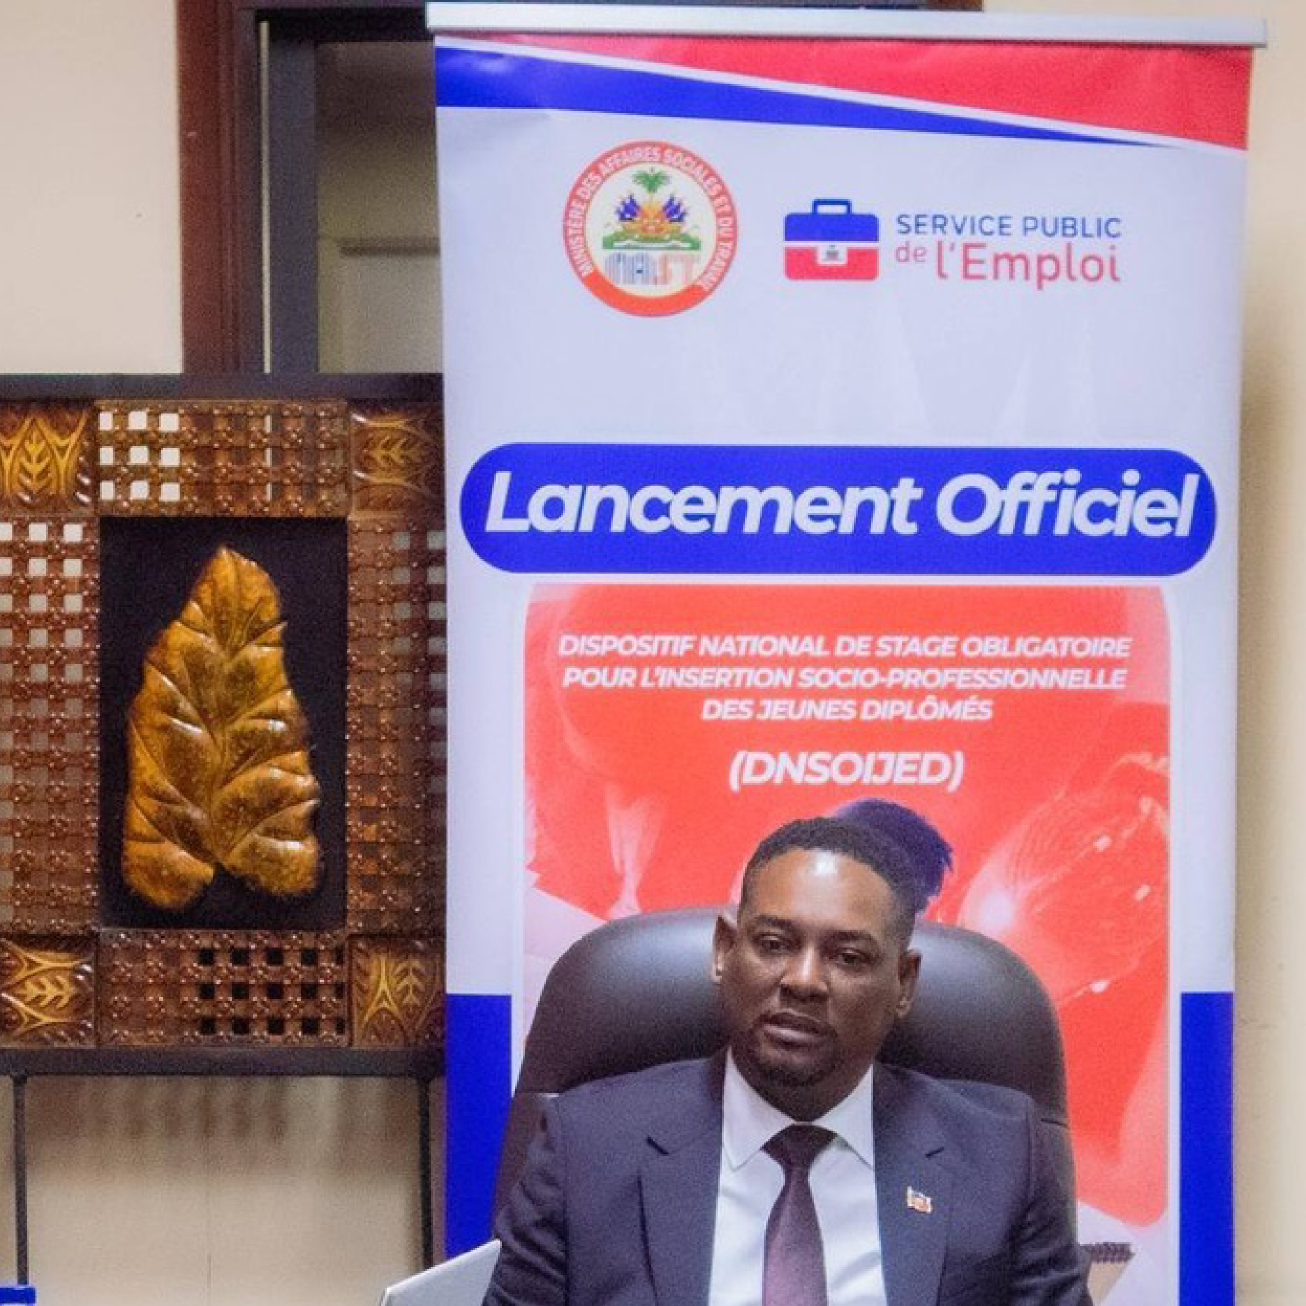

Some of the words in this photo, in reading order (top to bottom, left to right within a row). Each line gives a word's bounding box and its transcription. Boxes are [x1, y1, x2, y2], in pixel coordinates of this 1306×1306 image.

[896, 213, 1013, 236] SERVICE
[1022, 215, 1122, 238] PUBLIC
[895, 240, 928, 263] de
[936, 239, 1121, 291] l'Emploi
[484, 469, 923, 535] Lancement
[936, 468, 1200, 538] Officiel
[558, 635, 697, 656] DISPOSITIF
[698, 635, 831, 656] NATIONAL
[835, 635, 873, 657] DE
[875, 635, 959, 657] STAGE
[961, 635, 1133, 658] OBLIGATOIRE
[562, 666, 637, 688] POUR
[640, 666, 793, 688] L'INSERTION
[797, 667, 1128, 689] SOCIO-PROFESSIONNELLE
[701, 699, 754, 720] DES
[756, 699, 857, 720] JEUNES
[859, 694, 994, 720] DIPLÔMÉS
[729, 750, 964, 793] (DNSOIJED)
